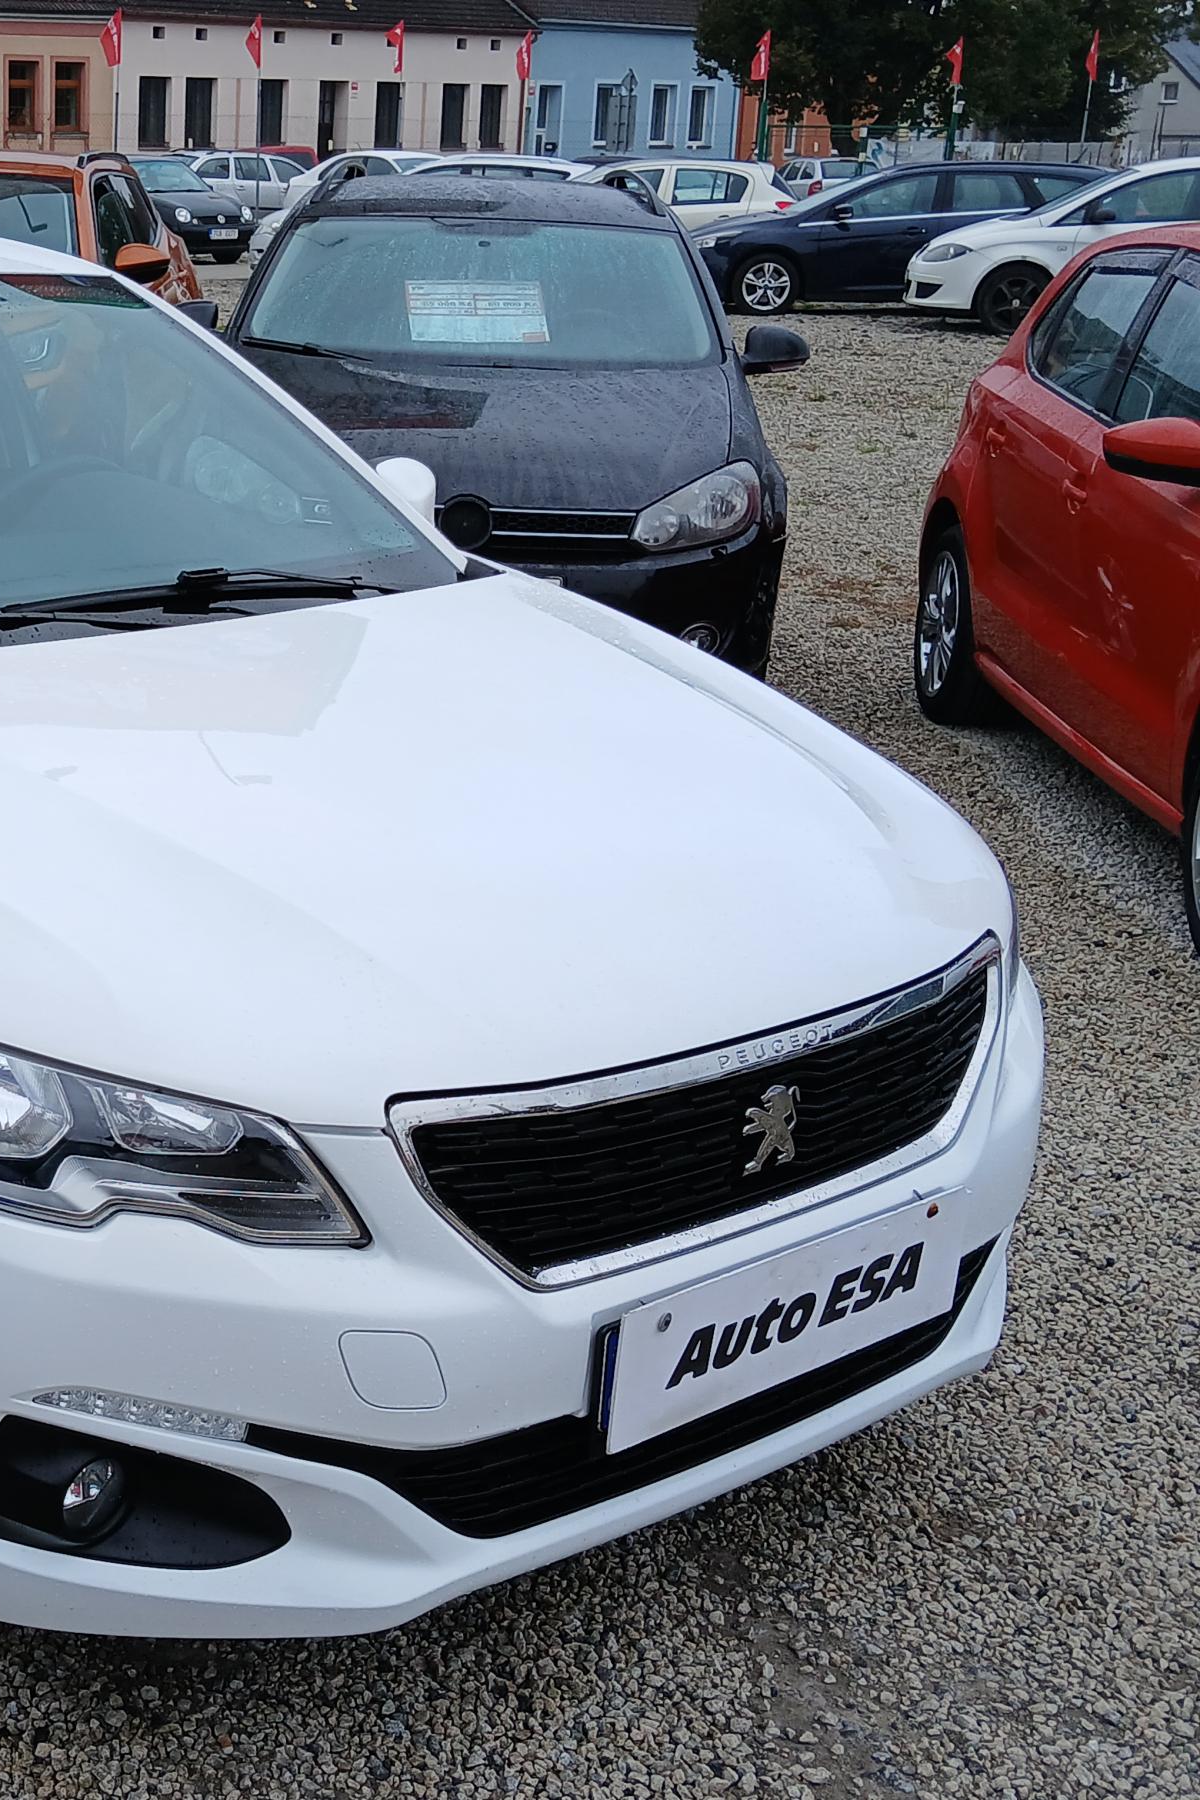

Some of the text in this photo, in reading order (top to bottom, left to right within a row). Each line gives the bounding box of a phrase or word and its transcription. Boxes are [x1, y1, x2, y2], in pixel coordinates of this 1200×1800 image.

[717, 1023, 833, 1070] PEUGEOT
[665, 1241, 924, 1389] Auto ESA
